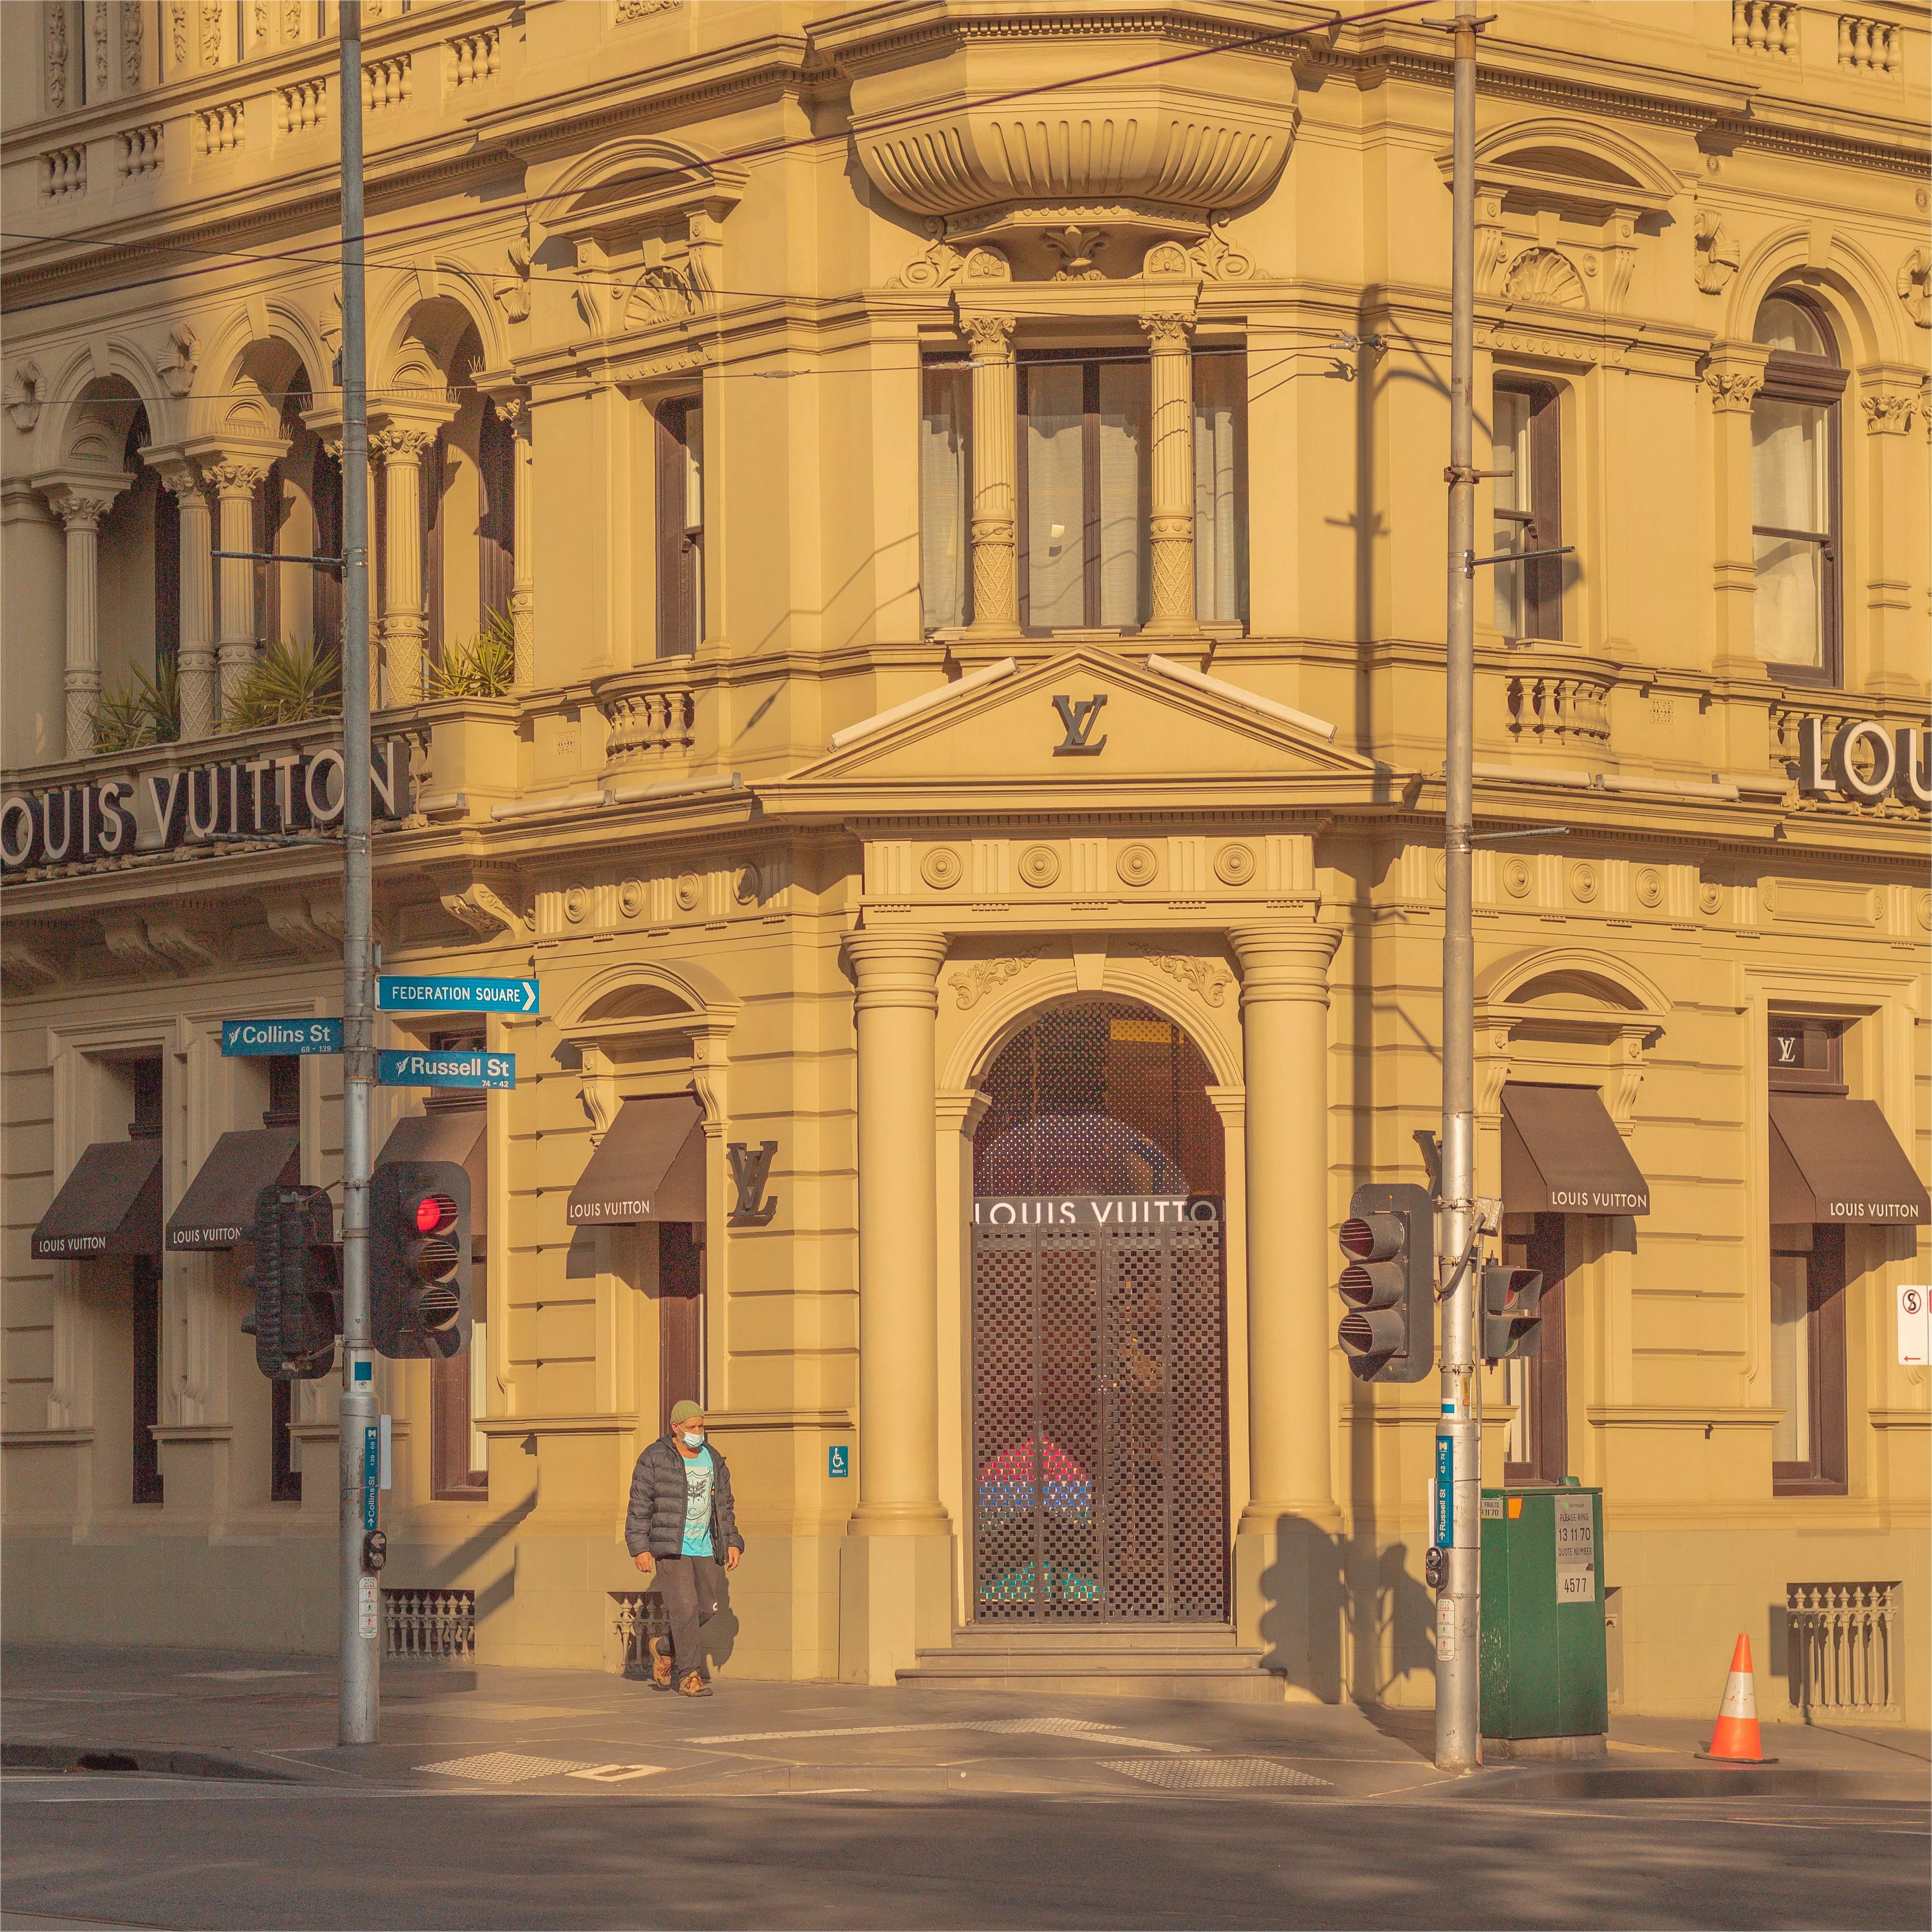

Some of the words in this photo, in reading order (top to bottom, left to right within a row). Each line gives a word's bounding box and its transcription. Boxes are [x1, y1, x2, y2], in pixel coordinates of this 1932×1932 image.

[147, 742, 396, 846] VUITTON
[393, 987, 470, 1000] FEDERATION
[476, 988, 520, 1002] SQUARE
[243, 1025, 304, 1043] Collins
[310, 1024, 330, 1042] St
[411, 1057, 481, 1076] Russell
[487, 1058, 509, 1076] St
[1553, 1192, 1588, 1205] LOUIS
[1593, 1193, 1647, 1208] VUITTON
[570, 1203, 600, 1218] LOUIS
[604, 1200, 650, 1215] VUITTON
[1091, 1200, 1225, 1227] VUITTO
[1831, 1203, 1864, 1216] LOUIS
[1869, 1204, 1918, 1217] VUITTON
[173, 1230, 199, 1243] LOUIS
[203, 1227, 242, 1241] VUITTON
[39, 1239, 64, 1252] LOUIS
[68, 1237, 105, 1251] VUITTON
[1441, 1465, 1445, 1474] 42
[368, 1476, 375, 1485] St
[1439, 1489, 1445, 1498] St
[1578, 1513, 1588, 1521] RING
[1559, 1528, 1568, 1541] 13
[1571, 1528, 1577, 1541] 11
[1580, 1527, 1590, 1540] 70
[1558, 1548, 1572, 1556] QUOTE
[1574, 1547, 1592, 1555] NUMBER
[1564, 1578, 1586, 1593] 4577
